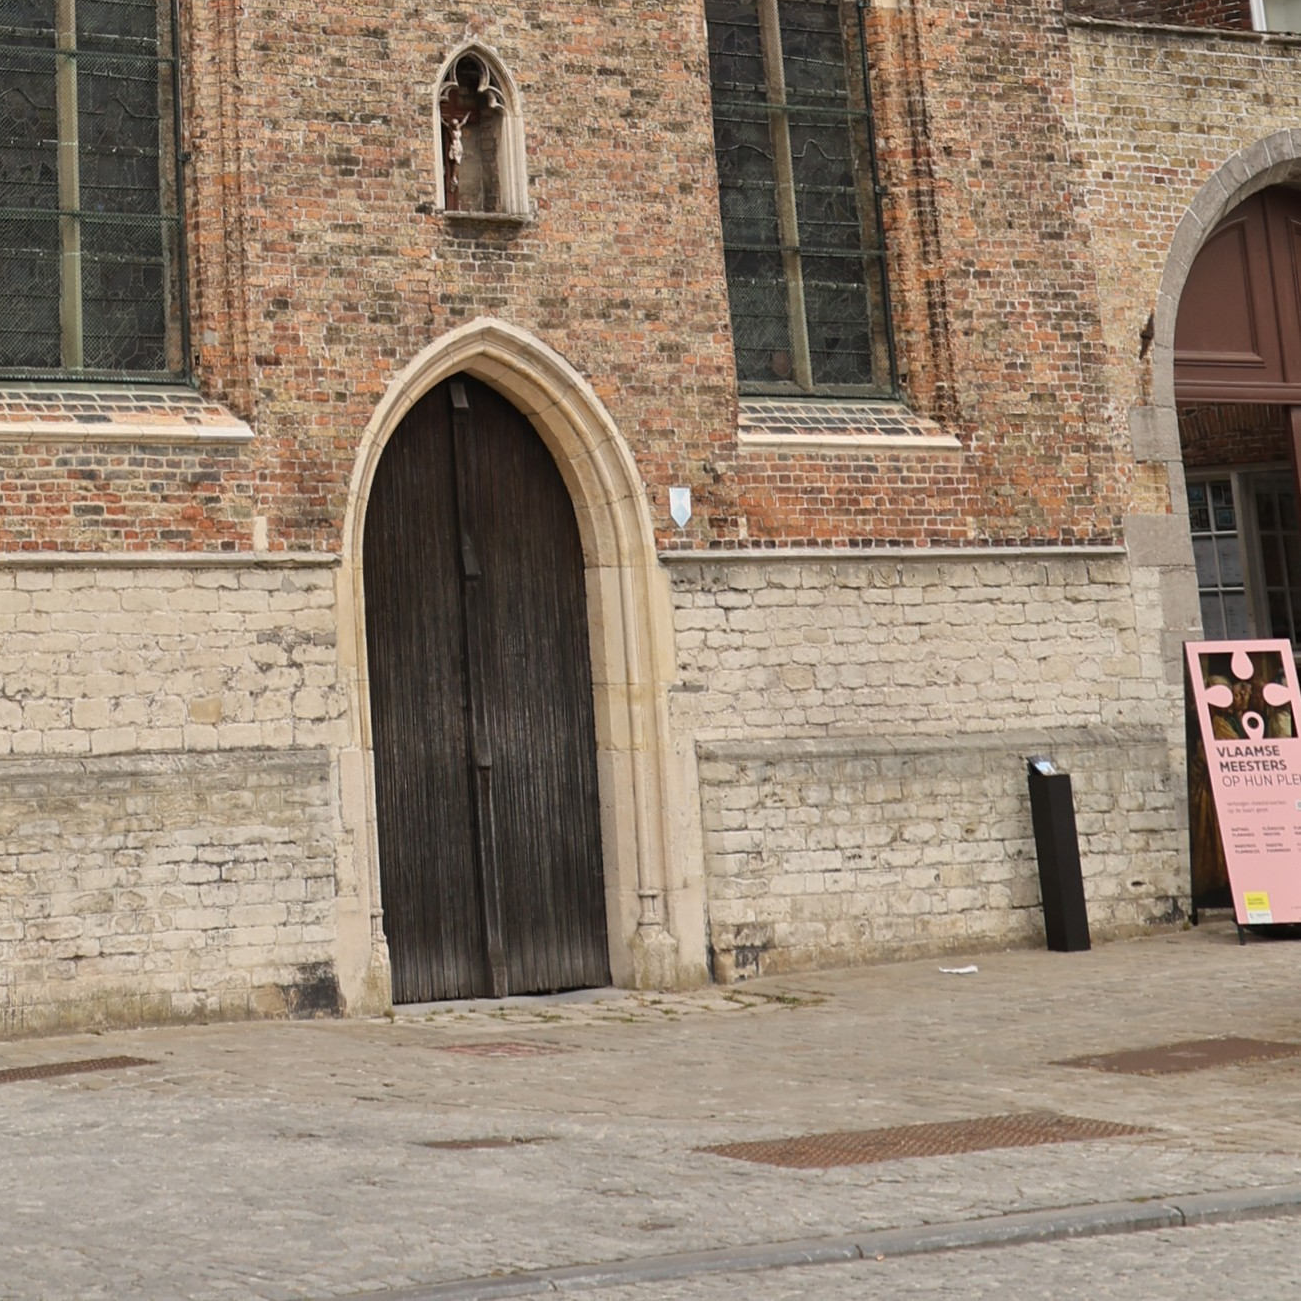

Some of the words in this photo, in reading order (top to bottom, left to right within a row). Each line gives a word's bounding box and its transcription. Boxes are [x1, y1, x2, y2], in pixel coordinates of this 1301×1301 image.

[1216, 745, 1280, 758] VLAAMSE
[1219, 759, 1287, 773] MEESTERS
[1222, 775, 1240, 787] OP
[1244, 774, 1273, 787] HUN
